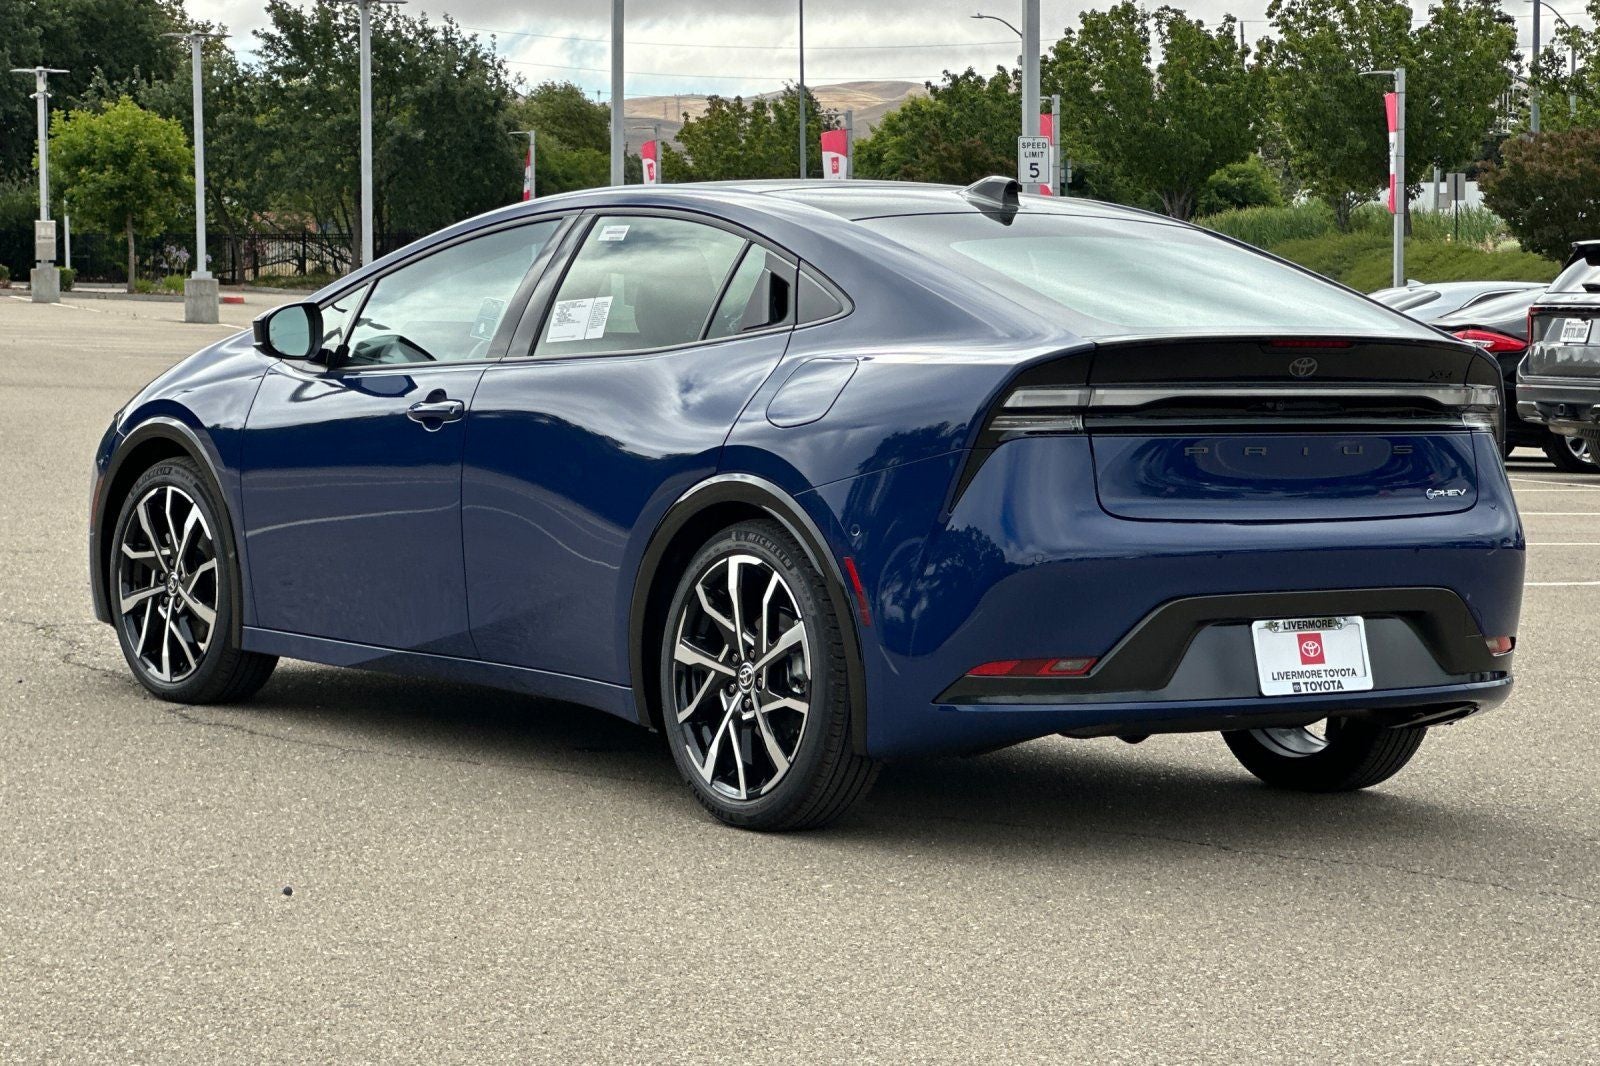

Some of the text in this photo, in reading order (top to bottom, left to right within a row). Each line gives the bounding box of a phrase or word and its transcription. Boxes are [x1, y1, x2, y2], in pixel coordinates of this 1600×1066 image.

[1029, 162, 1040, 178] 5
[1184, 445, 1413, 456] PRIUS
[746, 532, 792, 568] MICHELIN
[1283, 619, 1333, 630] LIVERMORE
[1271, 667, 1357, 681] LIVERMORE TOYOTA
[1303, 680, 1344, 692] TOYOTA
